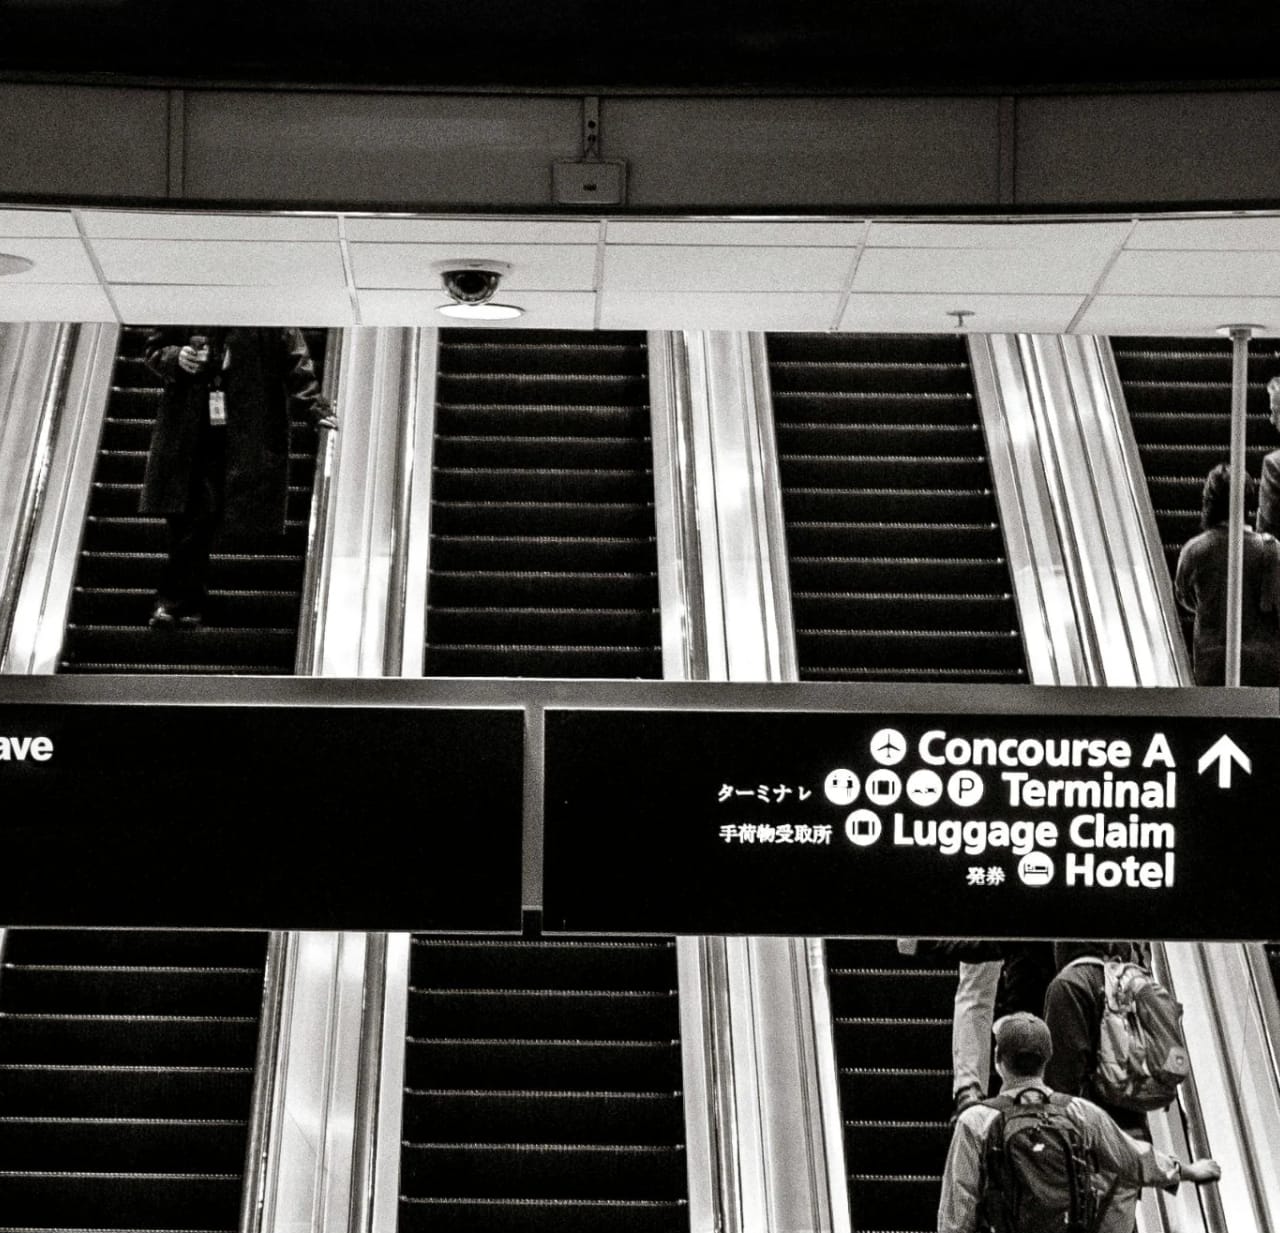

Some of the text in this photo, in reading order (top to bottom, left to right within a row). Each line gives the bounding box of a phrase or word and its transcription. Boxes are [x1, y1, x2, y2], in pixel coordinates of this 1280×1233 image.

[918, 730, 1176, 768] Concourse A
[1001, 771, 1176, 808] Terminal
[719, 823, 832, 845] 手荷物受取所
[894, 813, 1175, 855] Luggage Claim
[1066, 852, 1175, 888] Hotel
